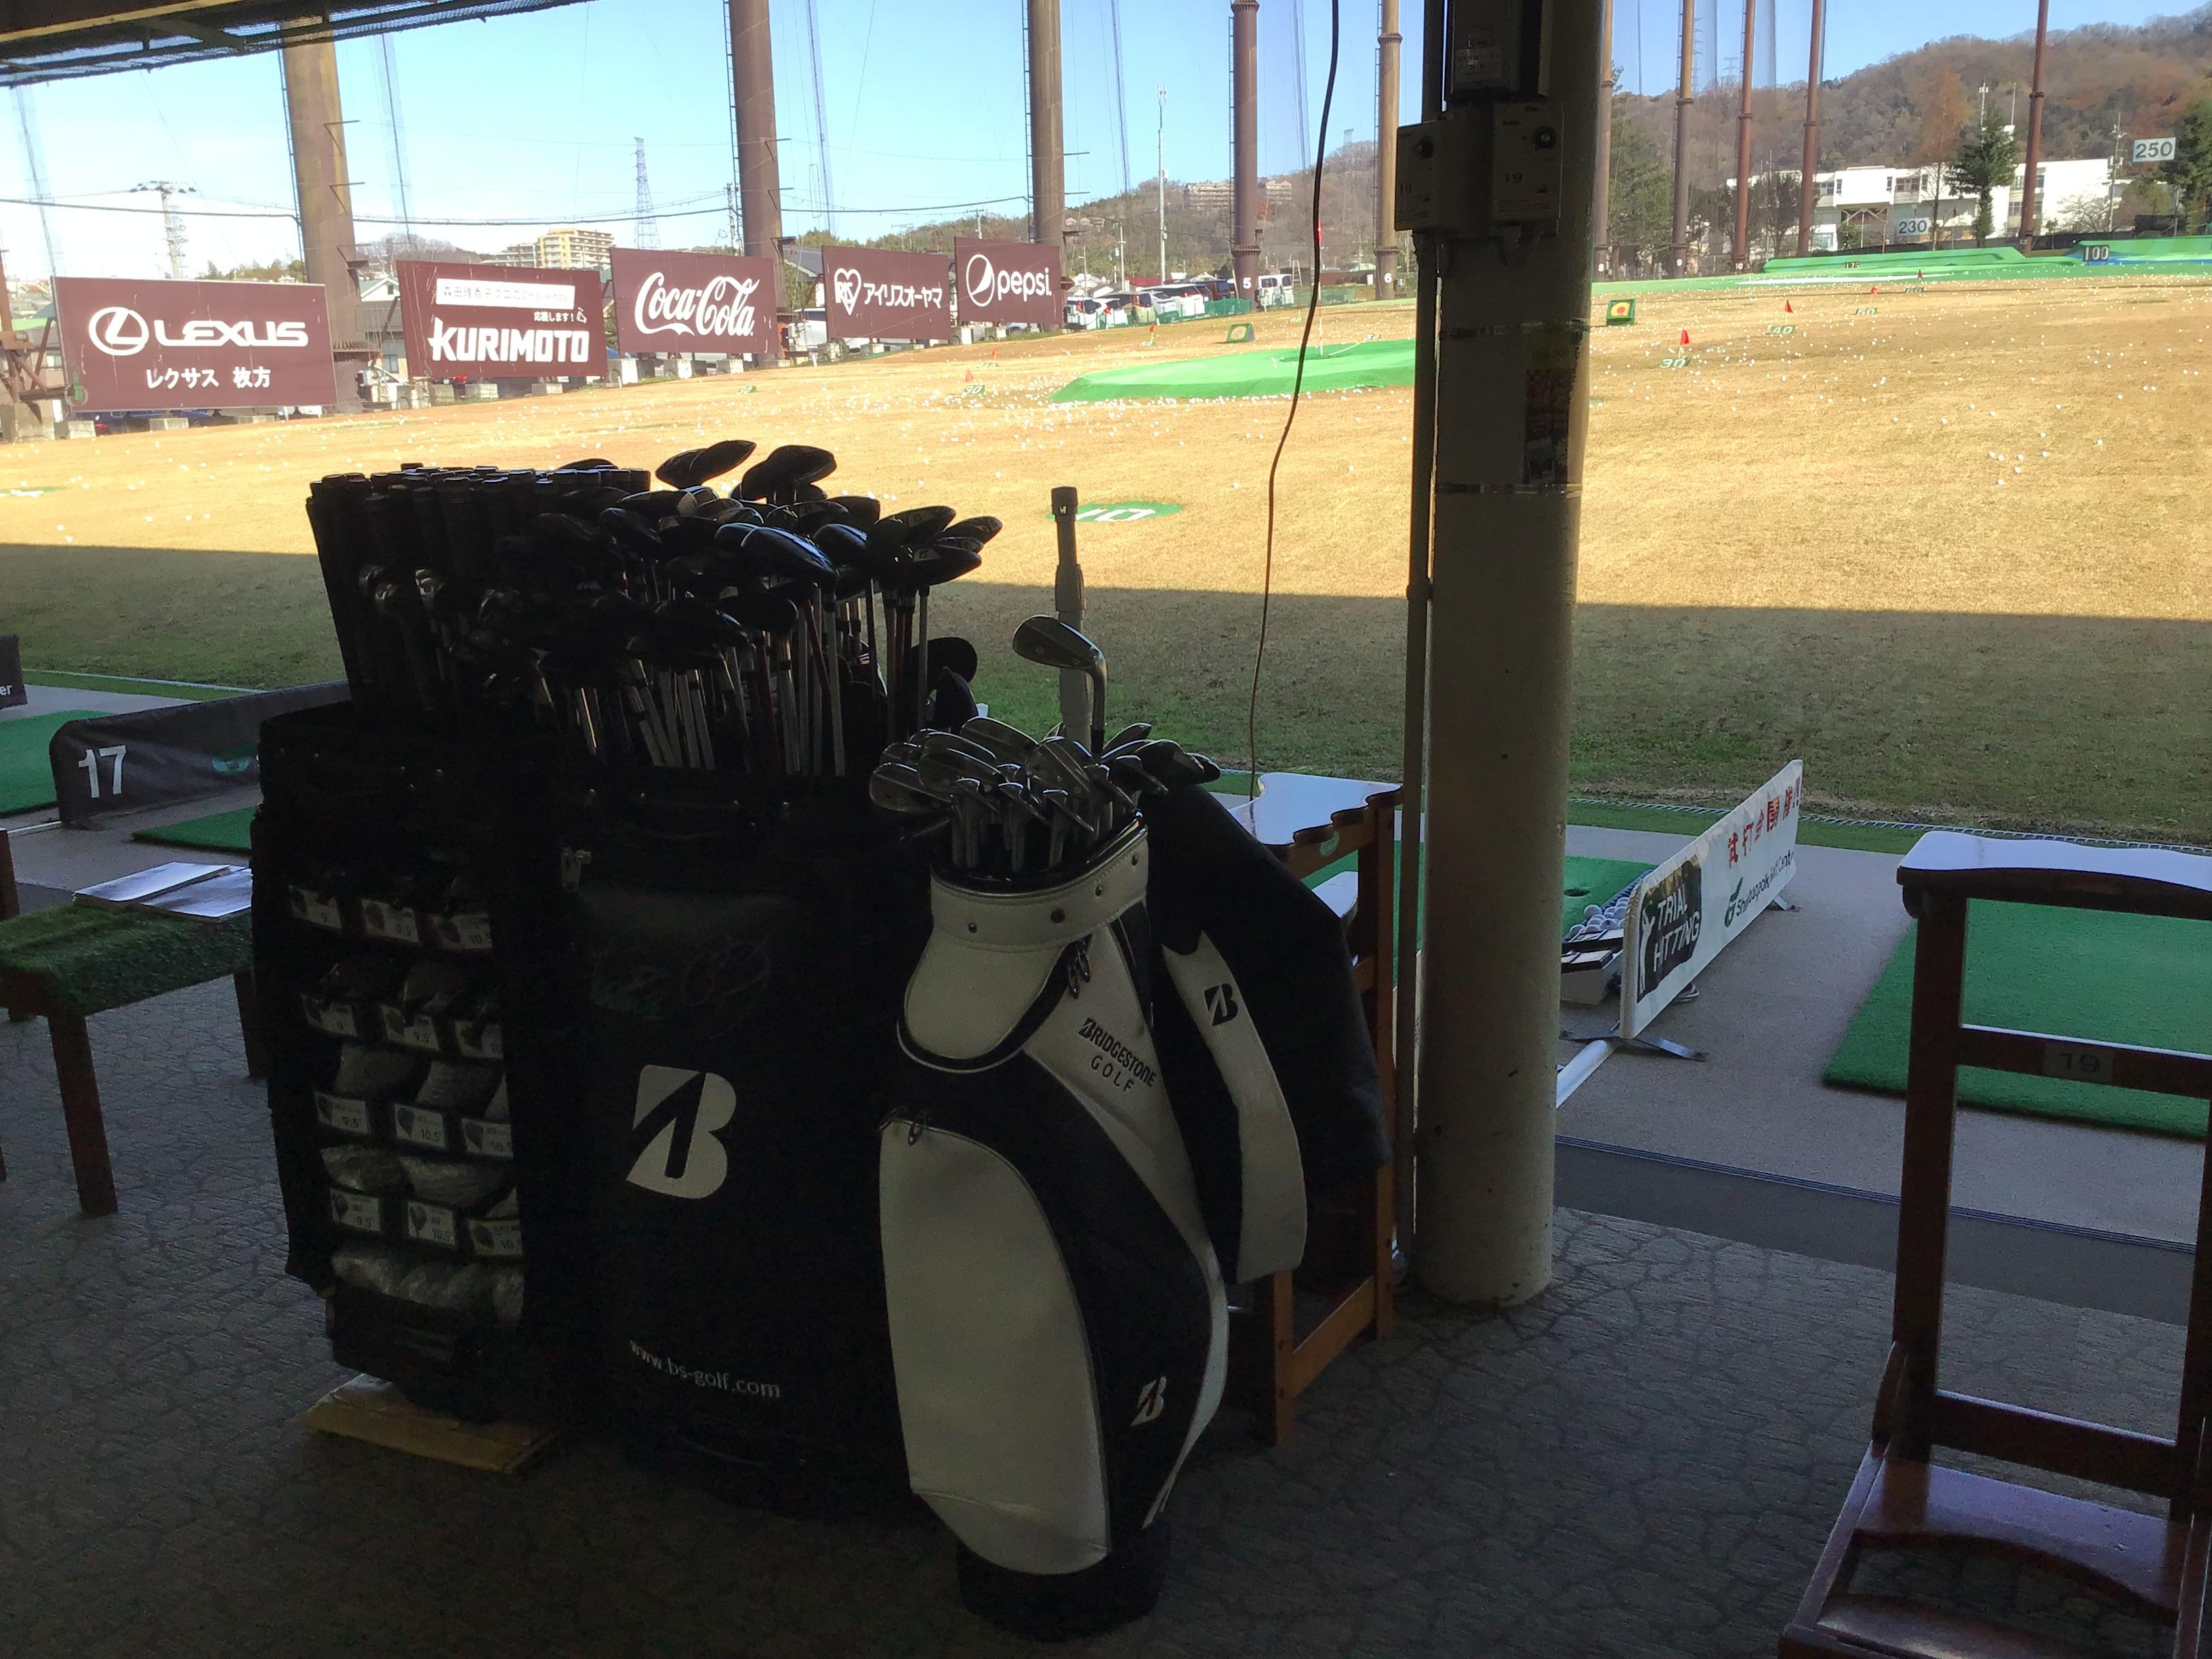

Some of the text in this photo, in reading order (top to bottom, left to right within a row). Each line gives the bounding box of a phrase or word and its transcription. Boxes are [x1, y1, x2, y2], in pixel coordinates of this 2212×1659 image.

[2135, 141, 2173, 159] 250
[1898, 220, 1927, 234] 230
[2085, 246, 2109, 261] 100
[1385, 272, 1393, 283] 6
[1846, 262, 1860, 270] 175
[1242, 277, 1252, 289] 5
[635, 272, 760, 337] Coca-Cola
[863, 283, 943, 308] アイリスオーヤマ
[154, 319, 309, 347] LEXUS
[428, 316, 590, 363] KURIMOTO
[1771, 326, 1793, 335] 40
[1660, 359, 1686, 369] 30
[146, 367, 271, 389] レクサス 枚方
[78, 745, 127, 798] 17
[1658, 883, 1687, 930] TRIAL
[1653, 911, 1700, 972] HITTING
[1078, 1018, 1157, 1088] BRIDGESTONE
[2060, 1052, 2100, 1073] 19
[1090, 1055, 1134, 1092] GOLF
[630, 1340, 780, 1399] www.bs-golf.com
